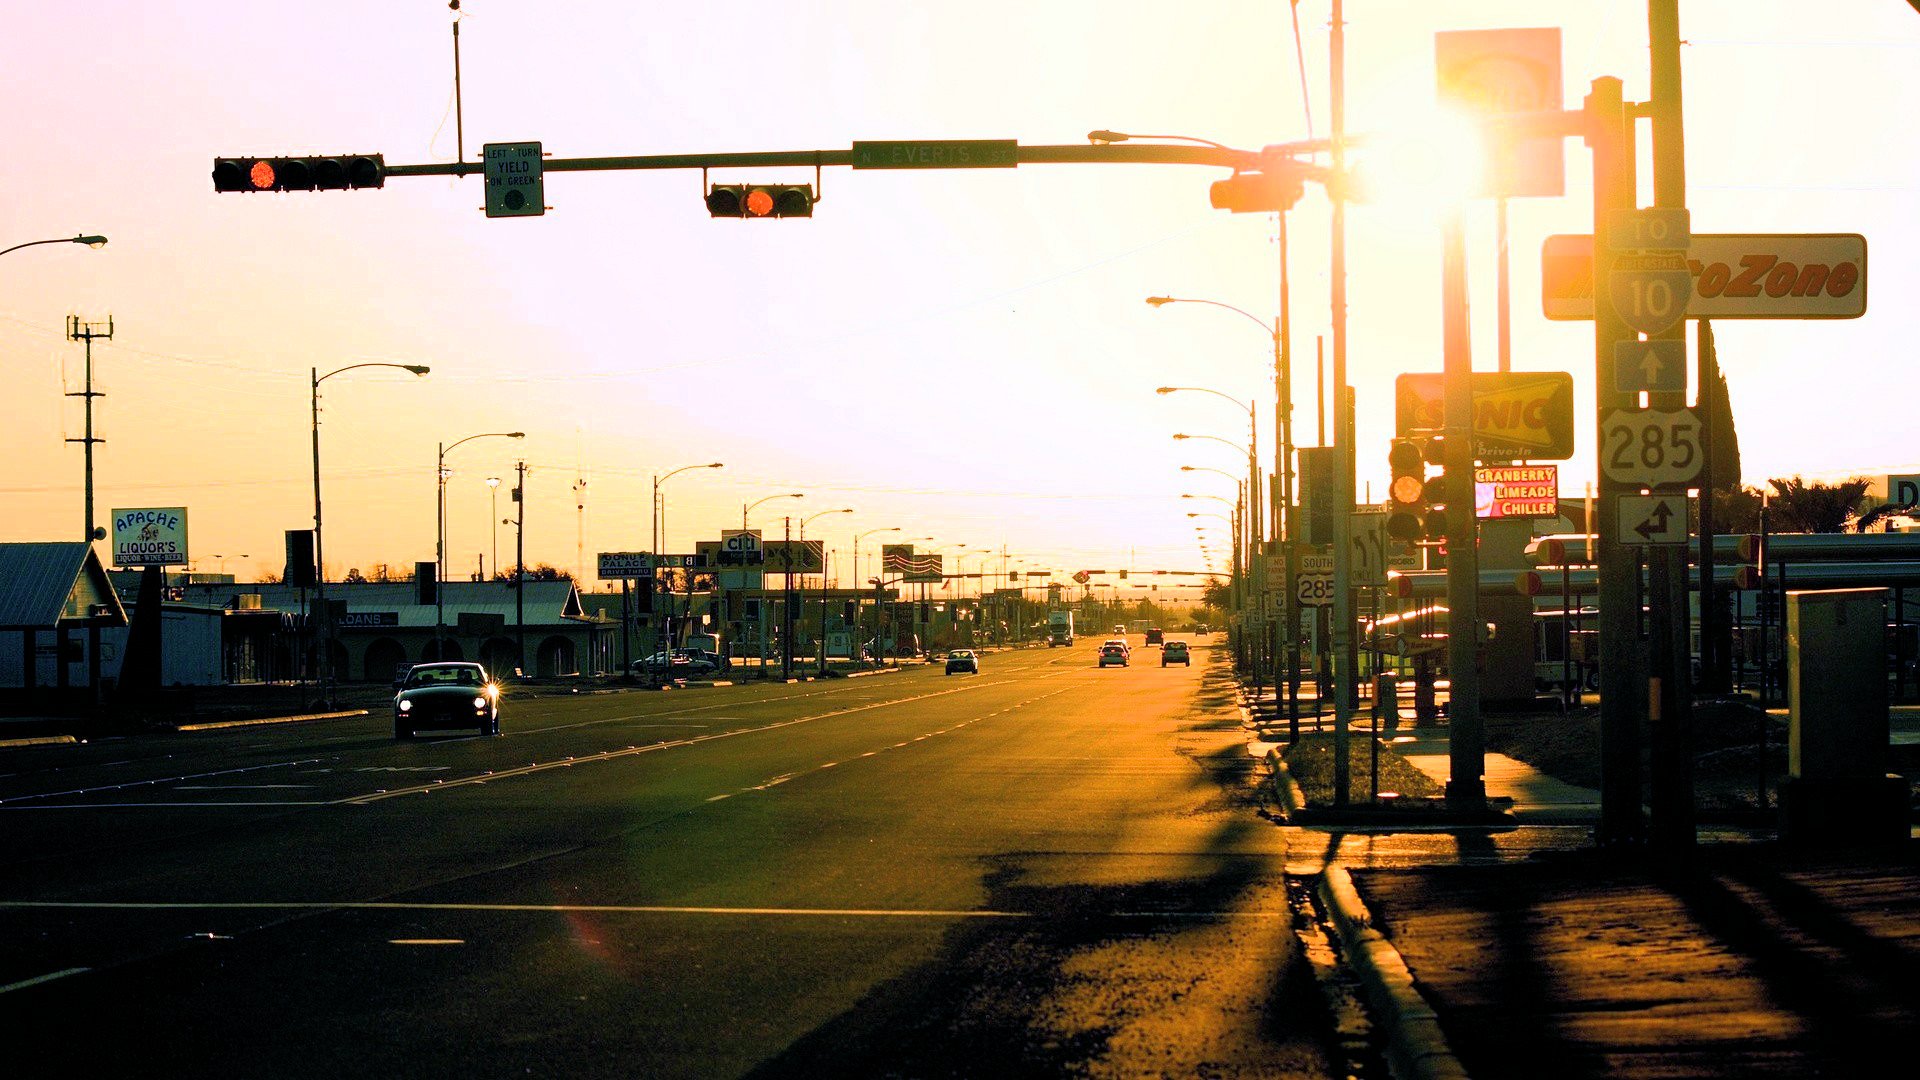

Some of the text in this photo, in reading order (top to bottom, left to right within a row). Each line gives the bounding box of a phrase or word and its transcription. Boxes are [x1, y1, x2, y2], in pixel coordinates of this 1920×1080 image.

[487, 148, 539, 159] LEFT TURN
[892, 145, 971, 163] EVERTS
[499, 161, 529, 173] YIELD
[490, 175, 535, 187] ON GREEN
[1631, 218, 1668, 241] TO
[1631, 279, 1672, 318] 10
[1424, 398, 1550, 430] SNIC
[1609, 424, 1695, 469] 285
[1475, 469, 1554, 483] CRANBERRY
[1495, 486, 1555, 499] LIMEADE
[1502, 502, 1555, 515] CHILLER
[116, 511, 179, 532] APACHE
[120, 541, 176, 554] LIQUOR'S
[602, 560, 647, 568] PALACE
[1303, 558, 1333, 568] SOUTH
[1300, 580, 1334, 598] 285
[339, 613, 381, 625] LOANS
